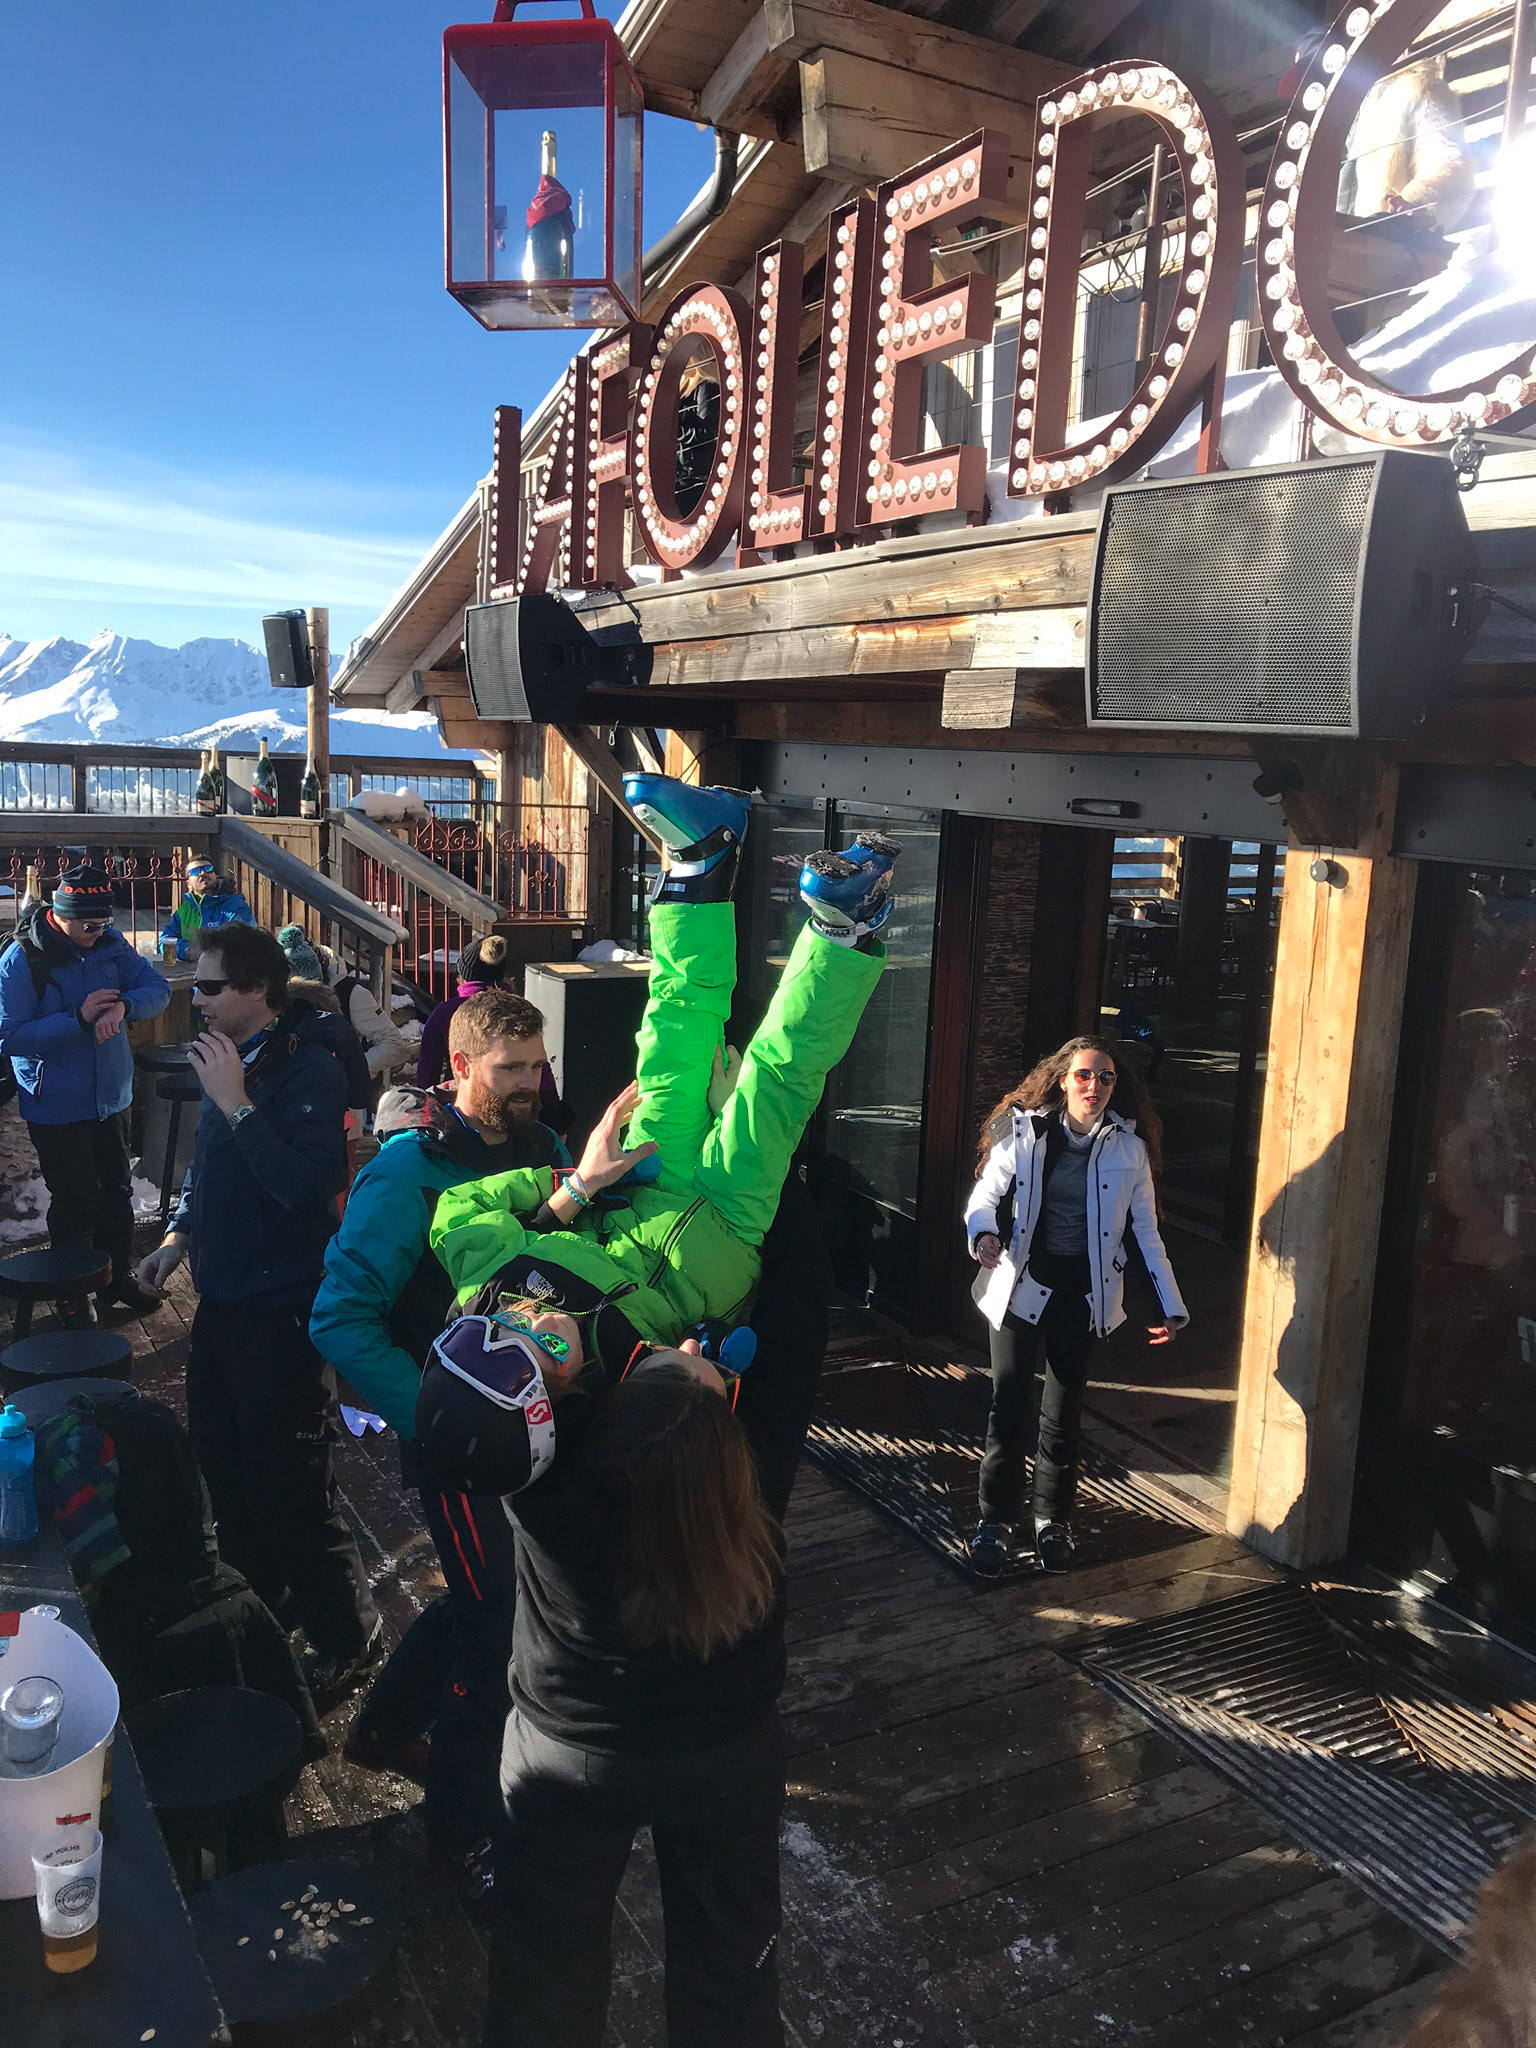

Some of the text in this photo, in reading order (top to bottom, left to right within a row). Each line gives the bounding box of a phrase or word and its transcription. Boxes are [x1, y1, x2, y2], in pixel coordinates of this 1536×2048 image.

[489, 354, 587, 599] LA
[581, 127, 1008, 588] FOLIE
[539, 1276, 555, 1292] FACE
